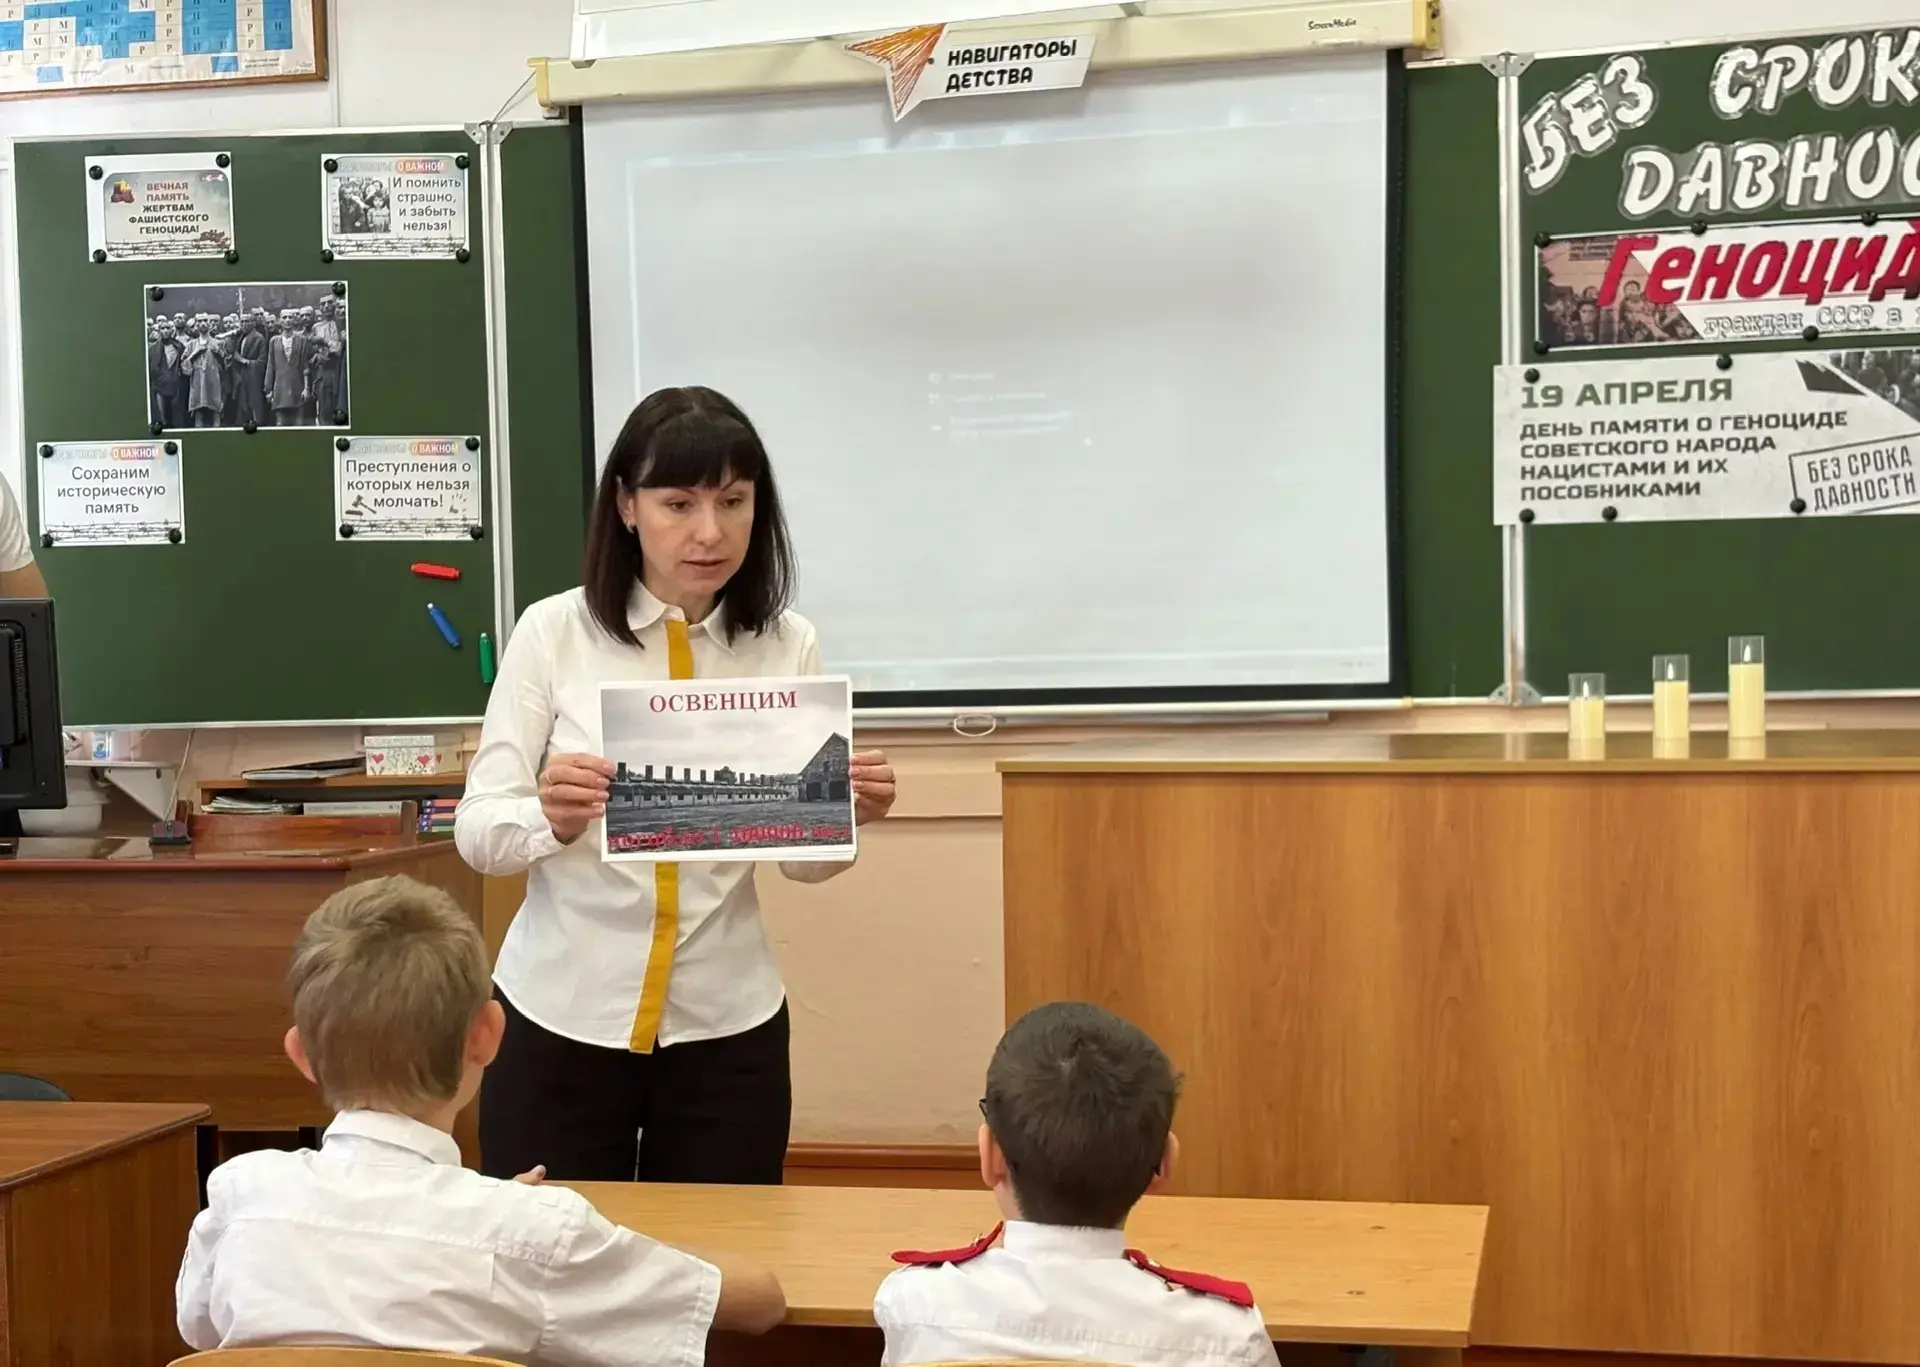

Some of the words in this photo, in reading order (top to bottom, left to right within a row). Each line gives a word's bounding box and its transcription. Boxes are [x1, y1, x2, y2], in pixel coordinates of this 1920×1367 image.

[947, 39, 1078, 66] НАВИГАТОРЫ
[945, 67, 1033, 93] ДЕТСТВА
[1521, 54, 1654, 190] БЕЗ
[405, 162, 445, 171] ВАЖНОМ
[147, 182, 188, 191] ВЕЧНАЯ
[393, 178, 402, 188] И
[406, 178, 461, 188] помнить
[146, 193, 190, 202] ПАМЯТЬ
[397, 193, 456, 204] страшно,
[143, 204, 194, 213] ЖЕРТВАМ
[399, 208, 406, 216] и
[410, 206, 456, 217] забыть
[129, 214, 209, 224] ФАШИСТСКОГО
[403, 219, 451, 231] нельзя!
[140, 225, 199, 235] ГЕНОЦИДА!
[1704, 313, 1803, 337] граждан
[1816, 305, 1874, 328] СССР
[1521, 385, 1564, 409] 19
[1575, 378, 1732, 407] АПРЕЛЯ
[1520, 422, 1583, 441] ДЕНЬ
[1591, 418, 1688, 435] ПАМЯТИ
[1697, 417, 1712, 431] О
[1721, 411, 1848, 431] ГЕНОЦИДЕ
[121, 448, 159, 457] ВАЖНОМ
[419, 444, 459, 453] ВАЖНОМ
[1521, 439, 1668, 458] СОВЕТСКОГО
[1677, 436, 1776, 454] НАРОДА
[346, 460, 457, 475] Преступления
[462, 462, 471, 472] о
[1521, 461, 1665, 481] НАЦИСТАМИ
[1674, 460, 1689, 474] И
[1698, 458, 1728, 474] ИХ
[1807, 457, 1841, 484] БЕЗ
[1847, 445, 1912, 476] СРОКА
[72, 466, 149, 482] Сохраним
[57, 485, 165, 499] историческую
[347, 480, 411, 493] которых
[416, 480, 470, 490] нельзя
[1521, 482, 1701, 501] ПОСОБНИКАМИ
[1814, 472, 1916, 512] ДАВНОСТИ
[374, 494, 443, 507] молчать!
[85, 503, 139, 514] память
[650, 690, 798, 712] ОСВЕНЦИМ
